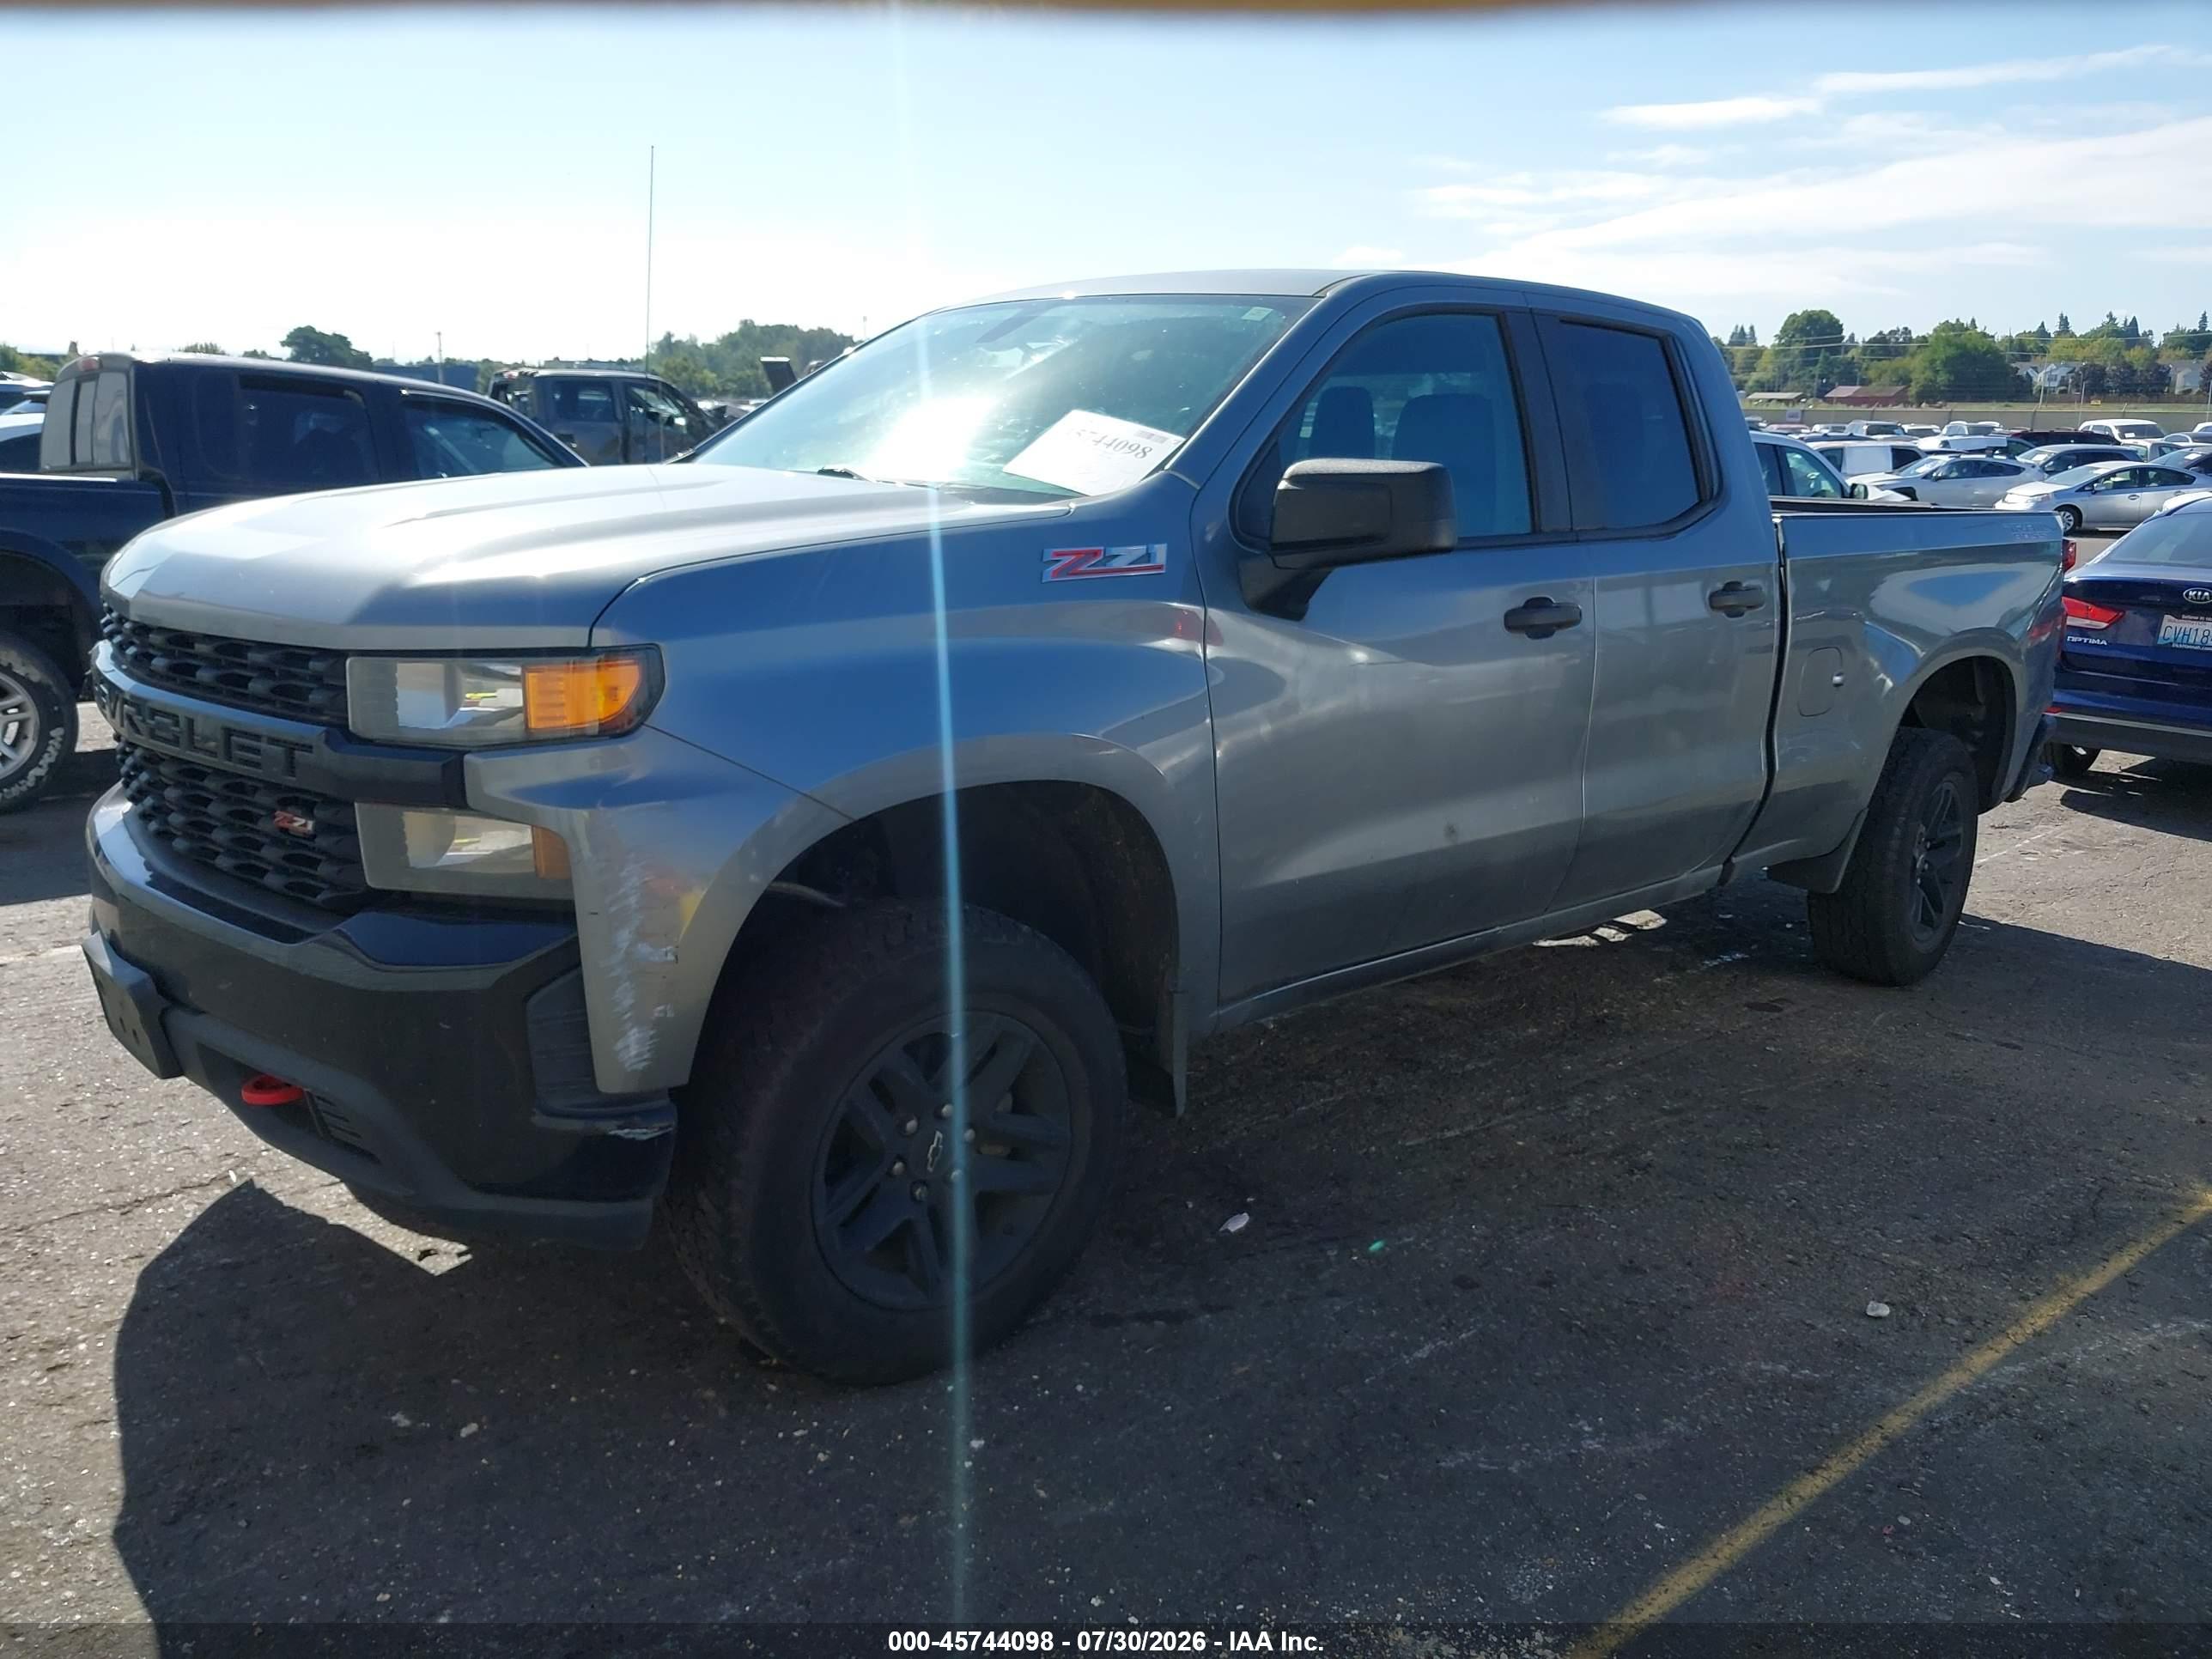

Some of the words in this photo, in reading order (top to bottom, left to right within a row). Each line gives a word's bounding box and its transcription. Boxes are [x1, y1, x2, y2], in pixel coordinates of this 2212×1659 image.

[2188, 590, 2211, 601] KIA
[2067, 635, 2108, 646] OPTIMA
[2162, 625, 2212, 646] CVH18
